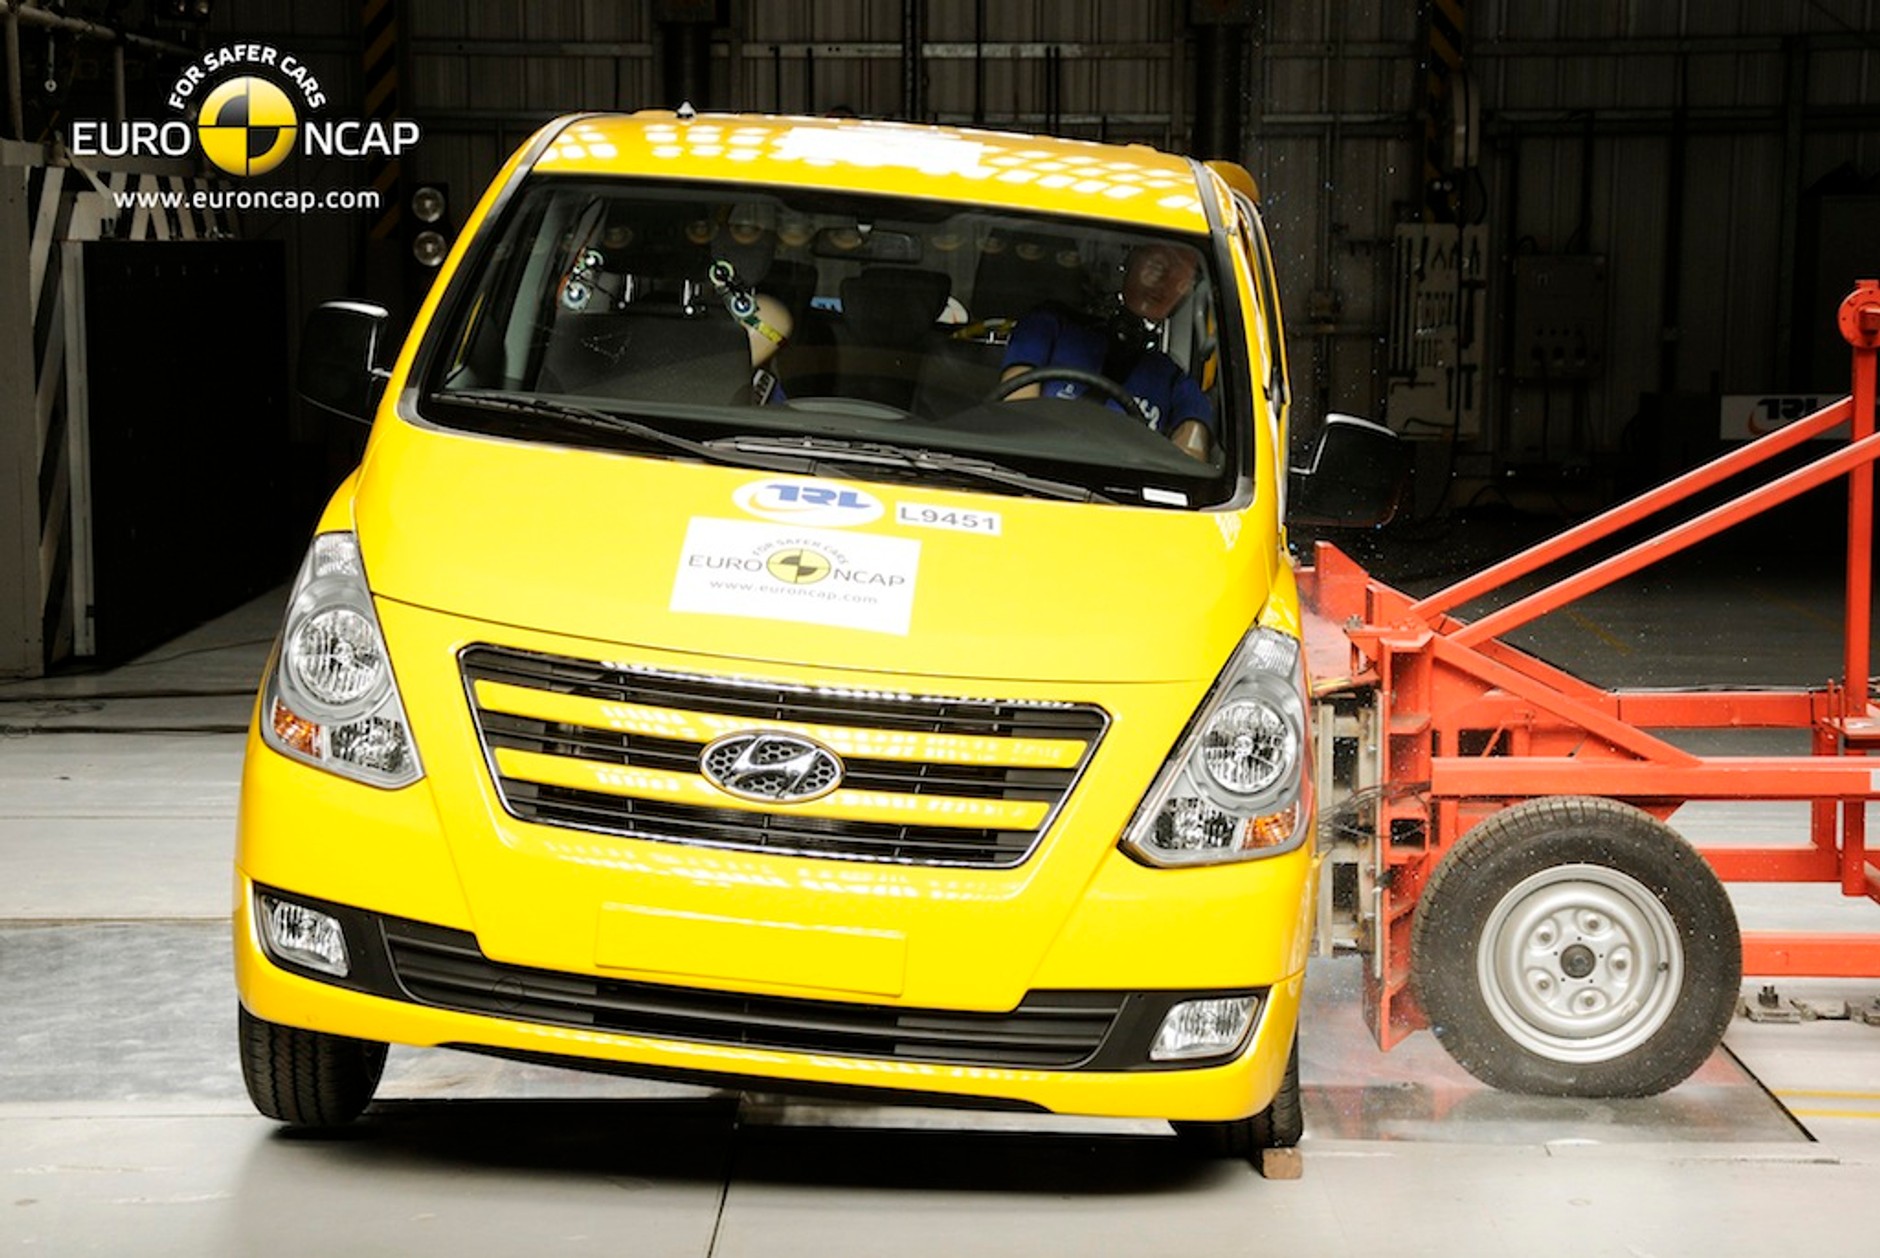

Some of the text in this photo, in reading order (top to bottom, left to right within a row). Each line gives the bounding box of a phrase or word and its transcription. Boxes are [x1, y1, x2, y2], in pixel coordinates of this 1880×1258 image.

[766, 484, 872, 509] TRL
[900, 506, 997, 531] L9451
[776, 537, 821, 549] SAFER
[688, 554, 906, 588] EURO NCAP
[709, 579, 878, 605] www.euroncap.com
